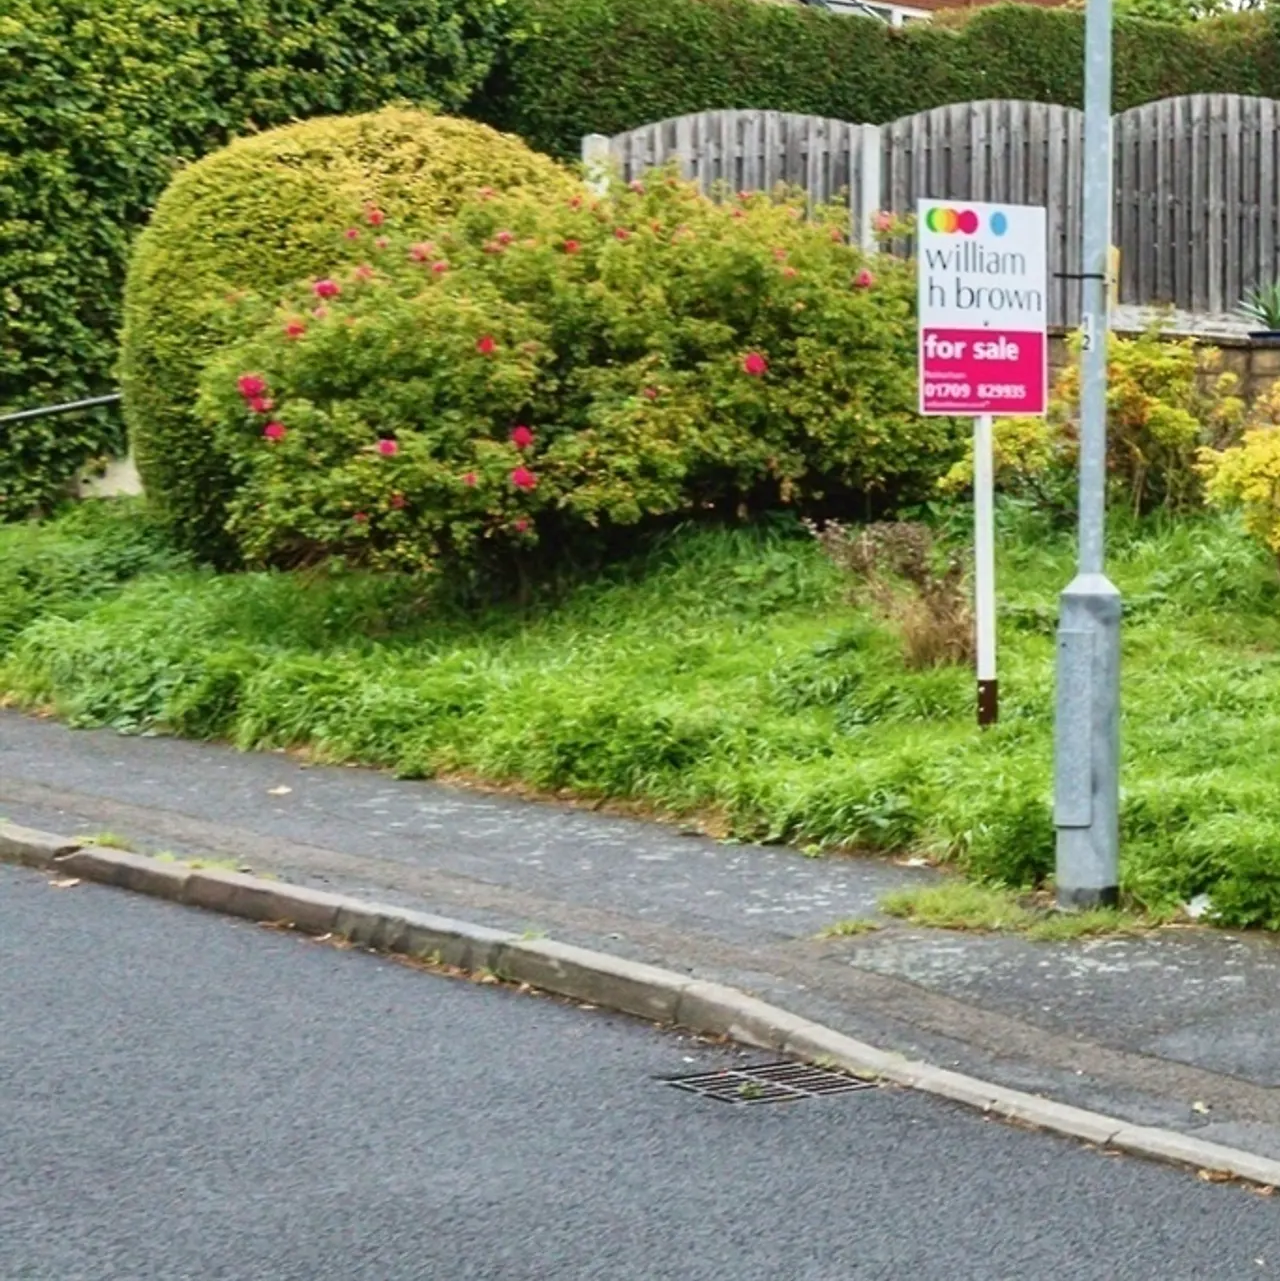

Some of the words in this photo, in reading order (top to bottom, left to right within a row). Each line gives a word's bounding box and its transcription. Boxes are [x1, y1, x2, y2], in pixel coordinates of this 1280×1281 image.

[925, 240, 1026, 275] william
[929, 276, 945, 307] h
[956, 277, 1042, 311] brown
[925, 334, 967, 359] for
[972, 335, 1020, 361] sale
[925, 382, 971, 398] 01709
